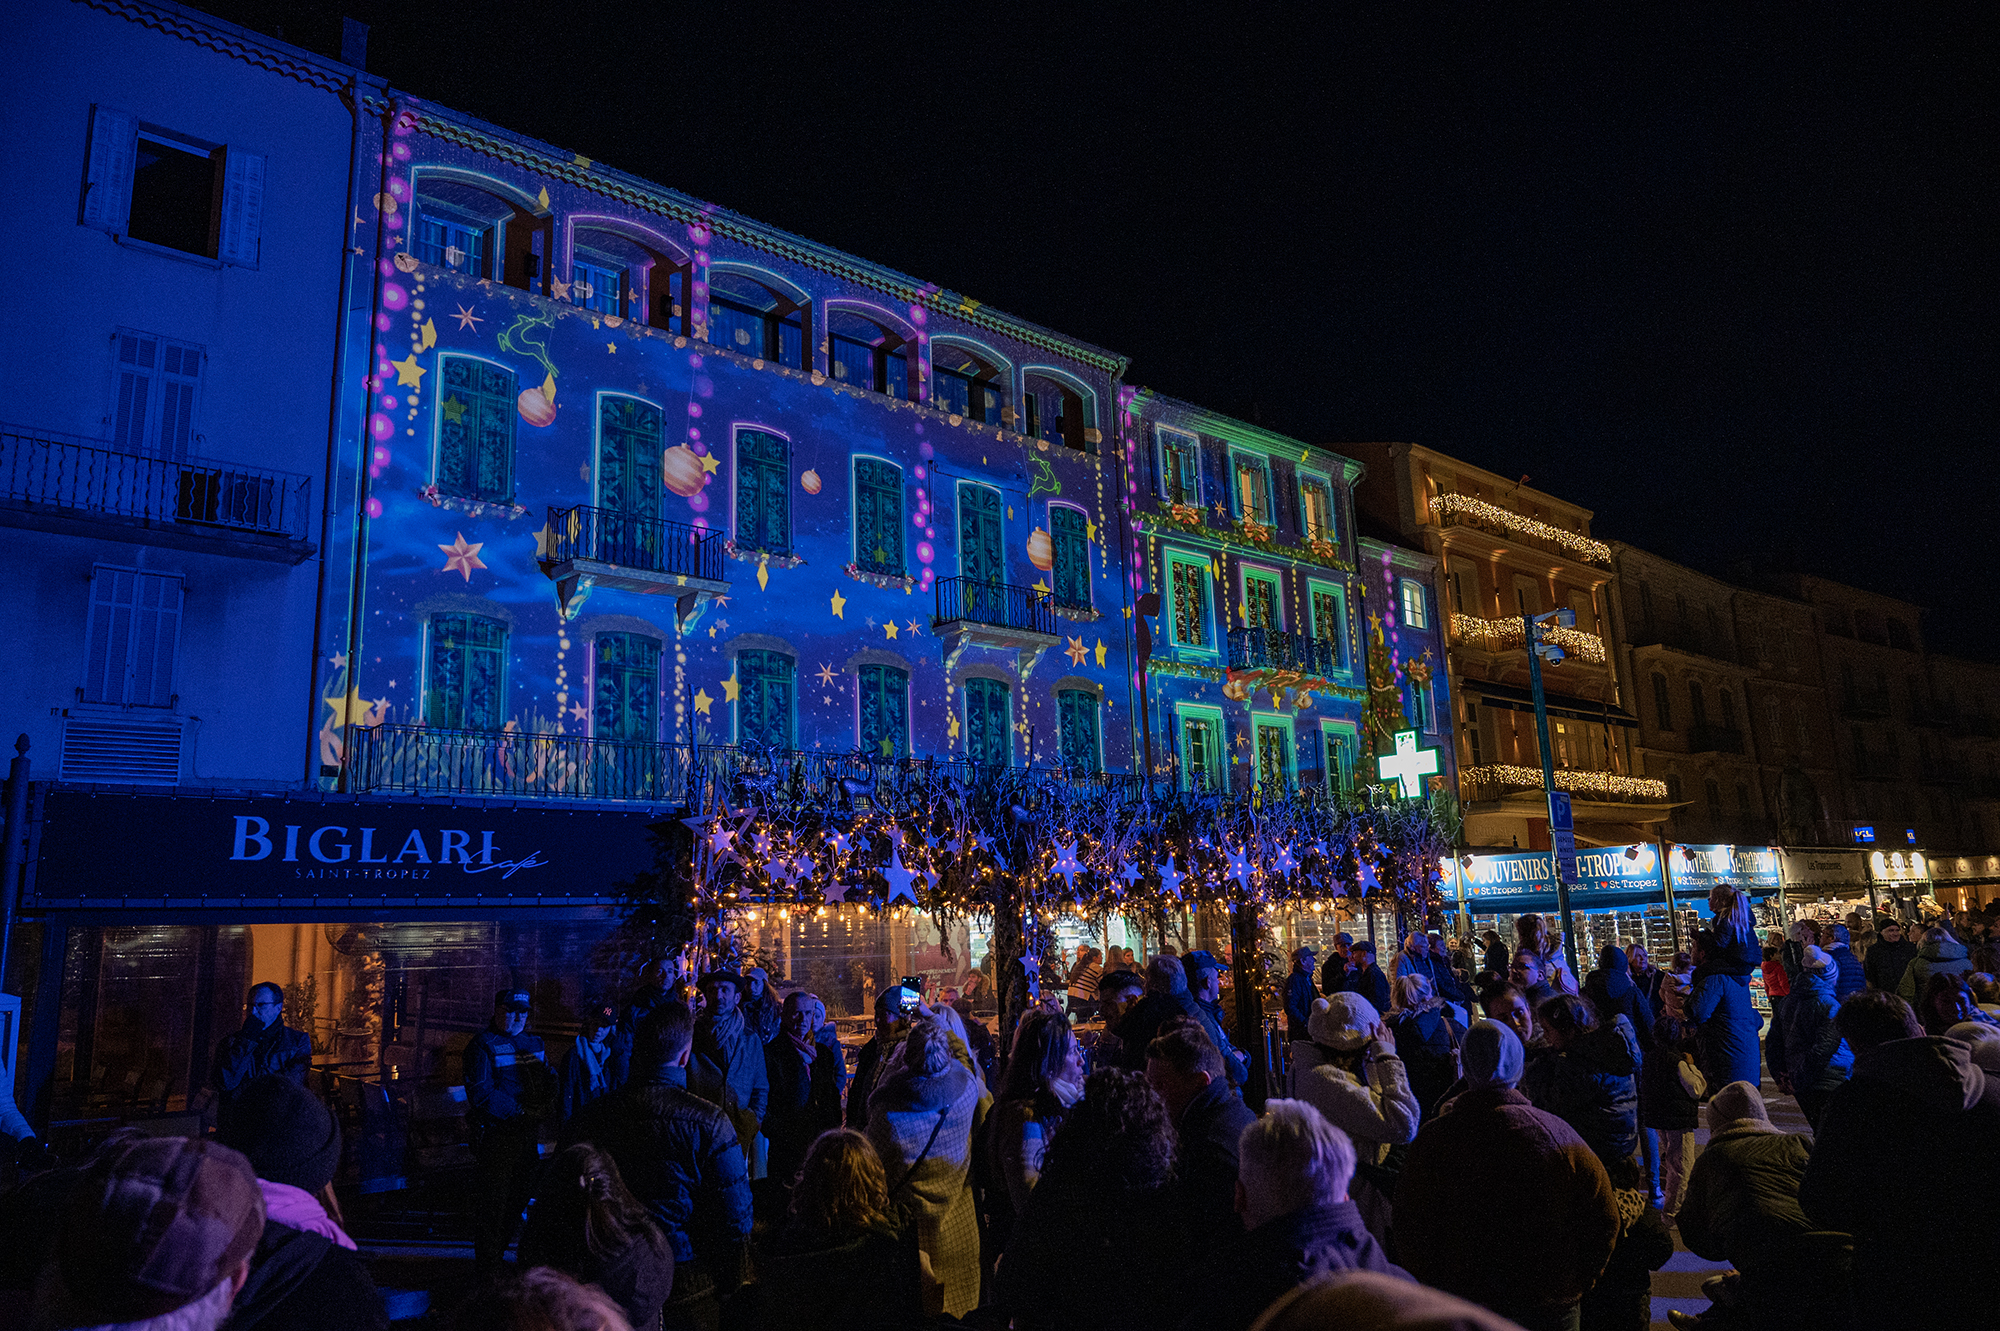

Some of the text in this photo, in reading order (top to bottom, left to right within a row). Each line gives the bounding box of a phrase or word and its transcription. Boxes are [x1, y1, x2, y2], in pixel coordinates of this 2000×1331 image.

[1556, 800, 1566, 821] P
[229, 815, 549, 880] BIGLARI Café
[295, 867, 431, 880] SAINT-TROPEZ
[1529, 884, 1534, 892] I
[1543, 883, 1554, 892] St
[1594, 879, 1657, 889] I St Tropez
[1467, 886, 1523, 896] I St Tropez
